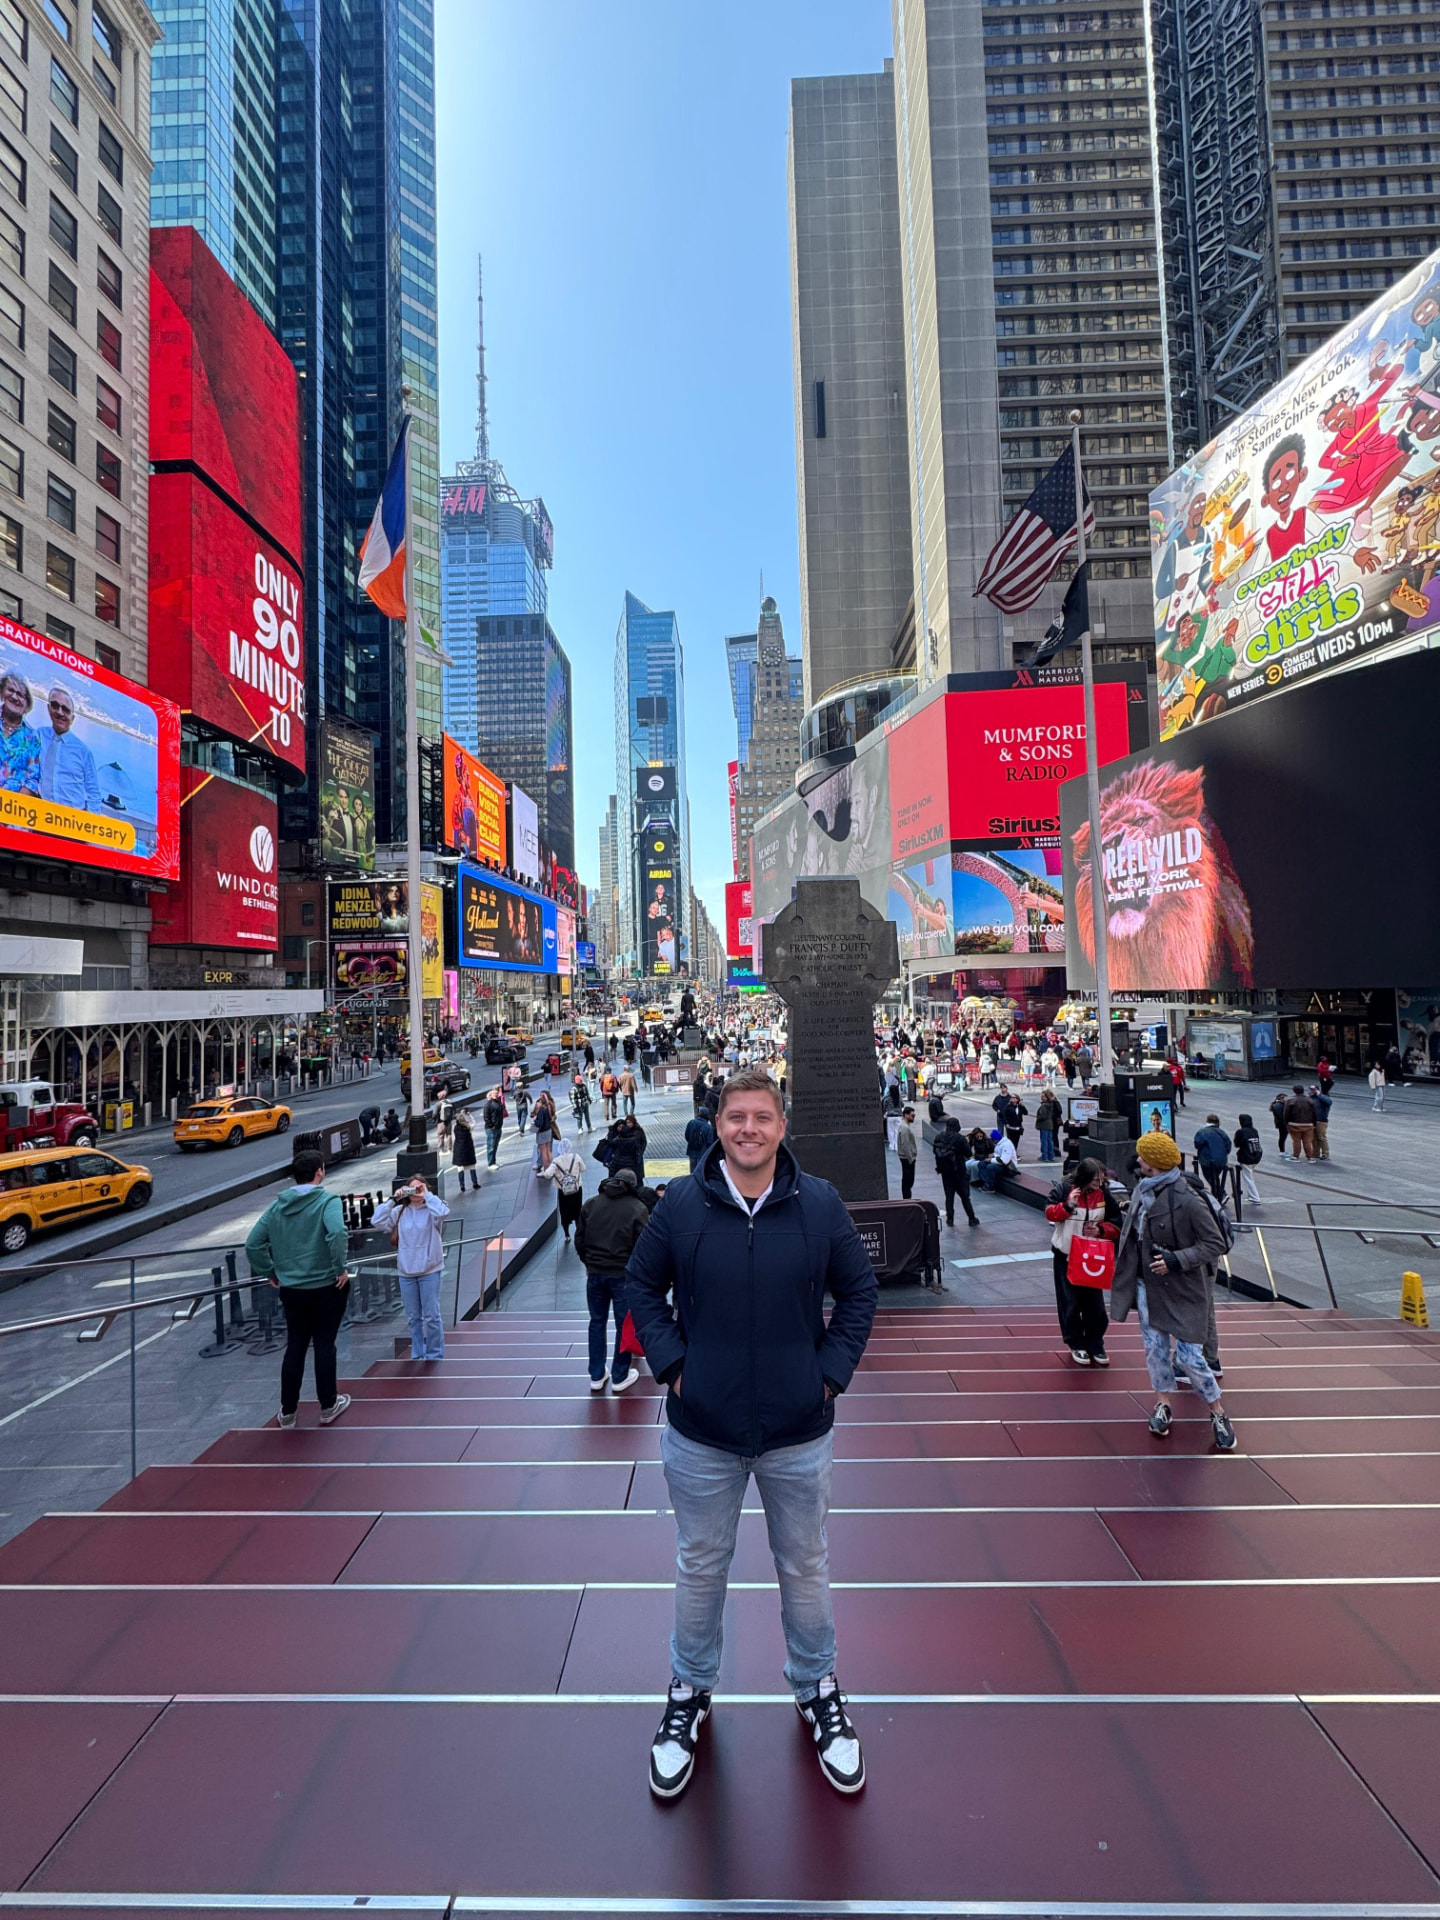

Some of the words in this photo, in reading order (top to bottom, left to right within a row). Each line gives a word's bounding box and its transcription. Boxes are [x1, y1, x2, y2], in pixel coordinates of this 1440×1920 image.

[1225, 441, 1246, 464] New
[1248, 408, 1290, 445] Stories.
[1292, 383, 1318, 410] New
[1320, 355, 1356, 388] Look.
[1252, 428, 1282, 457] Same
[1285, 401, 1320, 431] Chris.
[443, 485, 486, 515] H&M
[1236, 521, 1351, 600] everybody
[254, 552, 299, 623] ONLY
[1276, 580, 1329, 622] hates
[252, 597, 300, 669] 90
[1245, 586, 1361, 664] chris
[0, 619, 95, 676] GRATULATIONS
[1317, 630, 1356, 664] WEDS
[1356, 618, 1394, 646] 10PM
[1281, 648, 1316, 669] COMEDY
[1283, 658, 1318, 678] CENTRAL
[1038, 667, 1084, 676] MARRIOTT
[1038, 675, 1080, 684] MARQUIS
[1226, 685, 1242, 700] NEW
[1242, 674, 1265, 692] SERIES
[270, 705, 291, 747] TO
[983, 724, 1087, 745] MUMFORD
[999, 747, 1013, 762] &
[1020, 744, 1073, 761] SONS
[1006, 764, 1068, 782] RADIO
[478, 793, 500, 819] VISTA
[45, 809, 128, 844] anniversary
[988, 815, 1061, 834] Sirius
[479, 824, 500, 847] CLUB
[898, 823, 944, 854] SiriusXM
[217, 871, 261, 895] WIND
[1117, 876, 1146, 890] NEW
[1149, 868, 1190, 882] YORK
[341, 887, 371, 900] IDINA
[1107, 891, 1135, 902] FILM
[1138, 878, 1204, 897] FESTIVAL
[242, 897, 277, 912] BETHLEHEM
[335, 900, 377, 913] MENZEL
[332, 916, 380, 930] REDWOOD
[466, 905, 499, 932] Holland
[794, 934, 833, 942] LIEUTENANT
[834, 933, 866, 941] COLONEL
[924, 927, 947, 940] covered
[972, 925, 990, 935] we
[992, 924, 1014, 936] got
[1014, 924, 1037, 936] you
[1039, 923, 1066, 934] cove
[789, 943, 829, 953] FRANCIS
[840, 942, 874, 953] DUFFY
[204, 970, 249, 984] EXPRSS
[343, 1000, 390, 1008] LUGGAGE
[860, 1231, 878, 1241] MES
[863, 1240, 881, 1249] ARE
